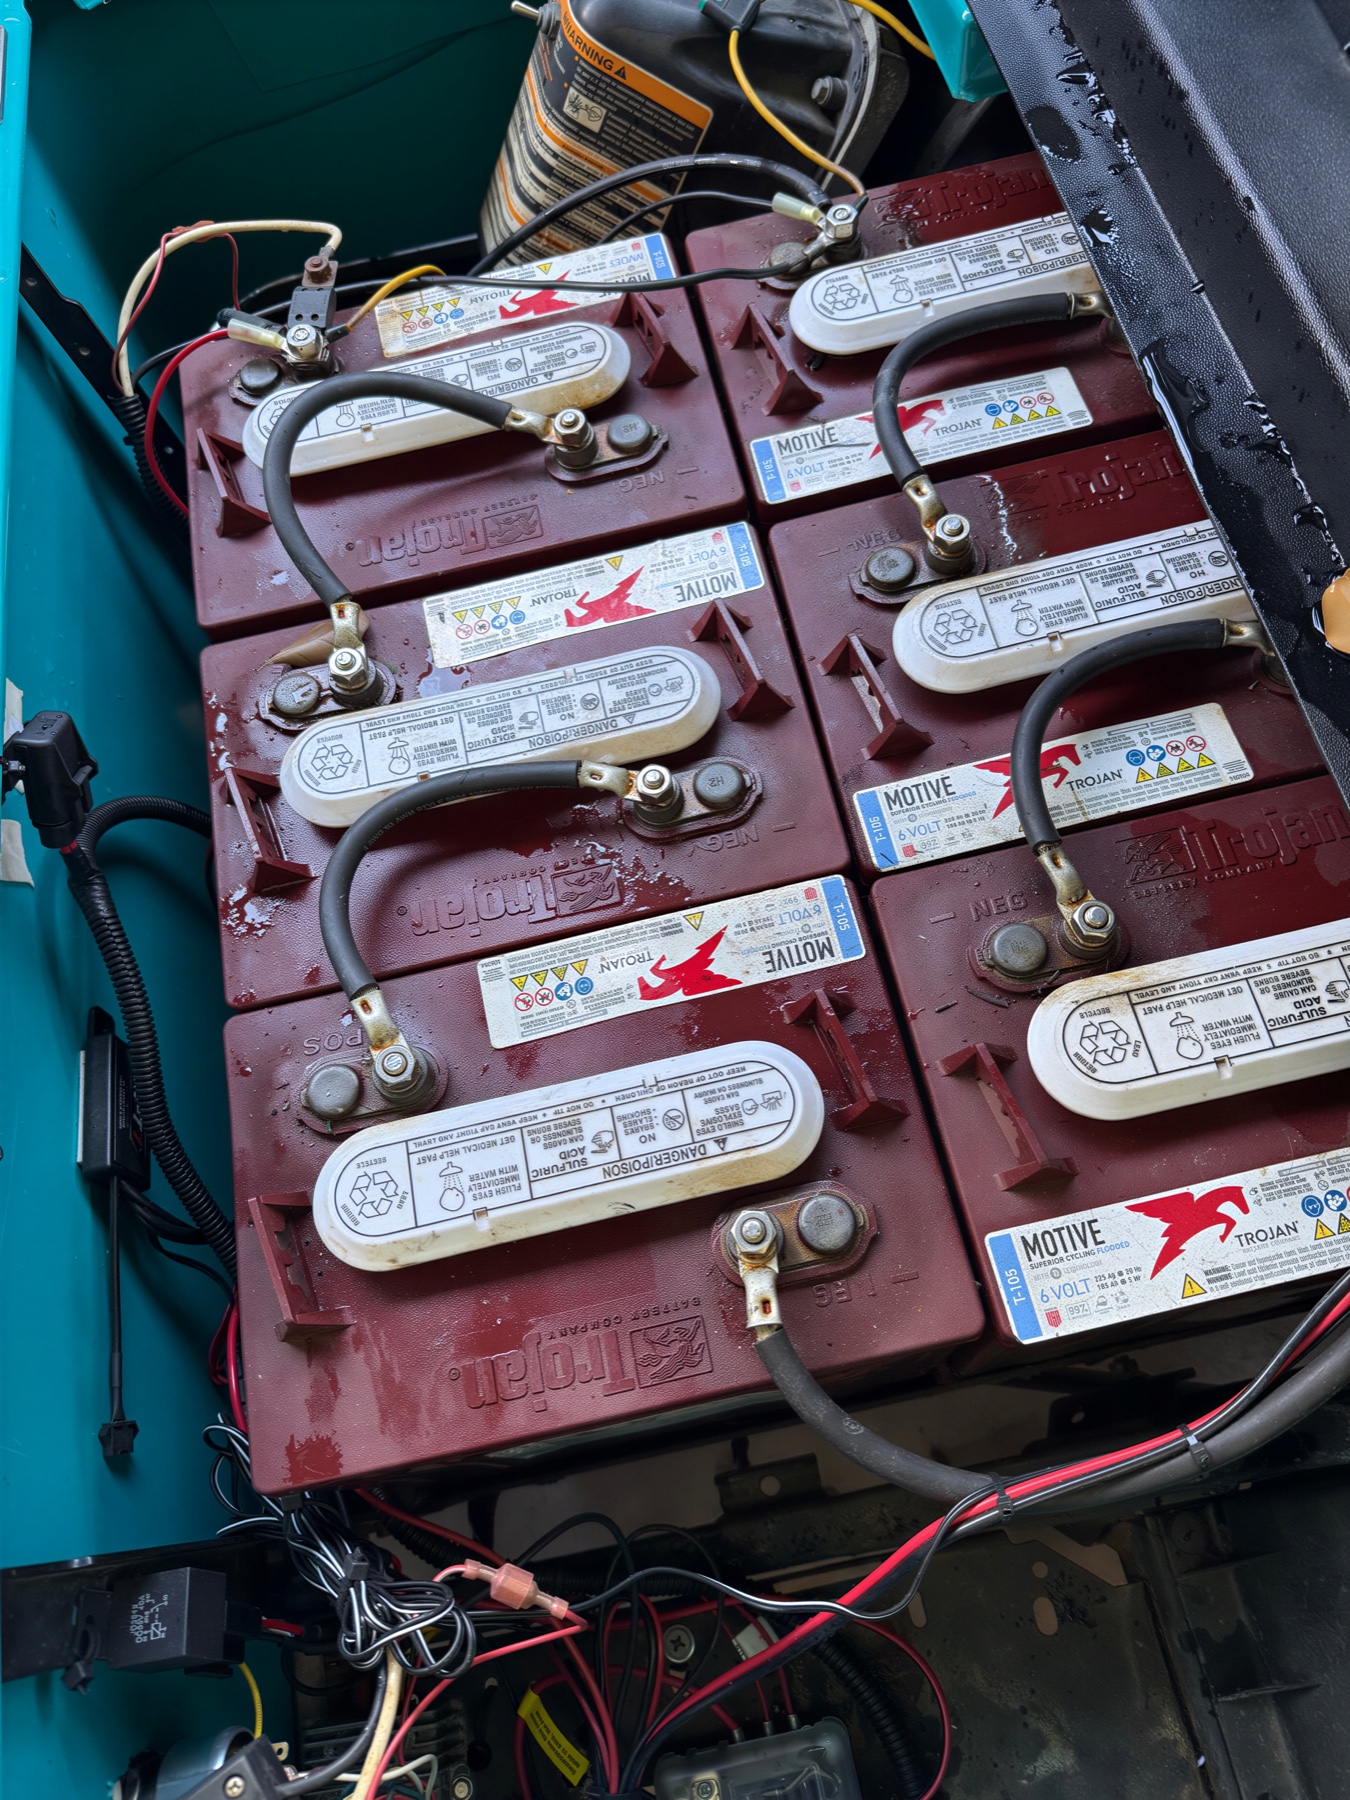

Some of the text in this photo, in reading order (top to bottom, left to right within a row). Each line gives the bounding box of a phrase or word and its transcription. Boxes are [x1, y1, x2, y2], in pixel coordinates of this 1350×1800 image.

[562, 12, 615, 71] WARNING
[775, 426, 838, 455] MOTIVE
[933, 418, 981, 436] TROJAN
[1037, 438, 1186, 516] Trojan
[352, 506, 486, 577] Trojan
[673, 571, 737, 602] MOTIVE
[883, 775, 955, 810] MOTIVE
[1065, 769, 1122, 791] TROJAN
[897, 820, 942, 840] 6 VOLT
[1184, 789, 1350, 885] Trojan
[404, 862, 557, 950] Trojan
[776, 906, 811, 925] VOLT
[833, 902, 850, 931] T-105
[968, 890, 1028, 921] NEG
[599, 950, 653, 972] TROJAN
[761, 935, 834, 973] MOTIVE
[1164, 998, 1186, 1010] HELP
[1267, 1005, 1326, 1027] SULFURIC
[1293, 995, 1320, 1009] ACID
[1201, 1013, 1251, 1031] WITH WATER
[301, 1026, 364, 1056] POS
[498, 1134, 515, 1145] GET
[638, 1132, 655, 1143] NO
[437, 1147, 460, 1159] HELP
[558, 1145, 586, 1160] ACID
[601, 1142, 706, 1179] DANGER/POISON
[468, 1163, 518, 1182] WITH WATER
[531, 1157, 588, 1178] SULFURIC
[471, 1182, 521, 1201] FLUSH EYES
[1020, 1217, 1105, 1262] MOTIVE
[1234, 1220, 1298, 1248] TROJAN
[1029, 1240, 1130, 1270] SUPERIOR CYCLING FLOODED
[1004, 1267, 1026, 1305] T-105
[1038, 1277, 1092, 1303] 6 VOLT
[454, 1314, 635, 1426] Trojan
